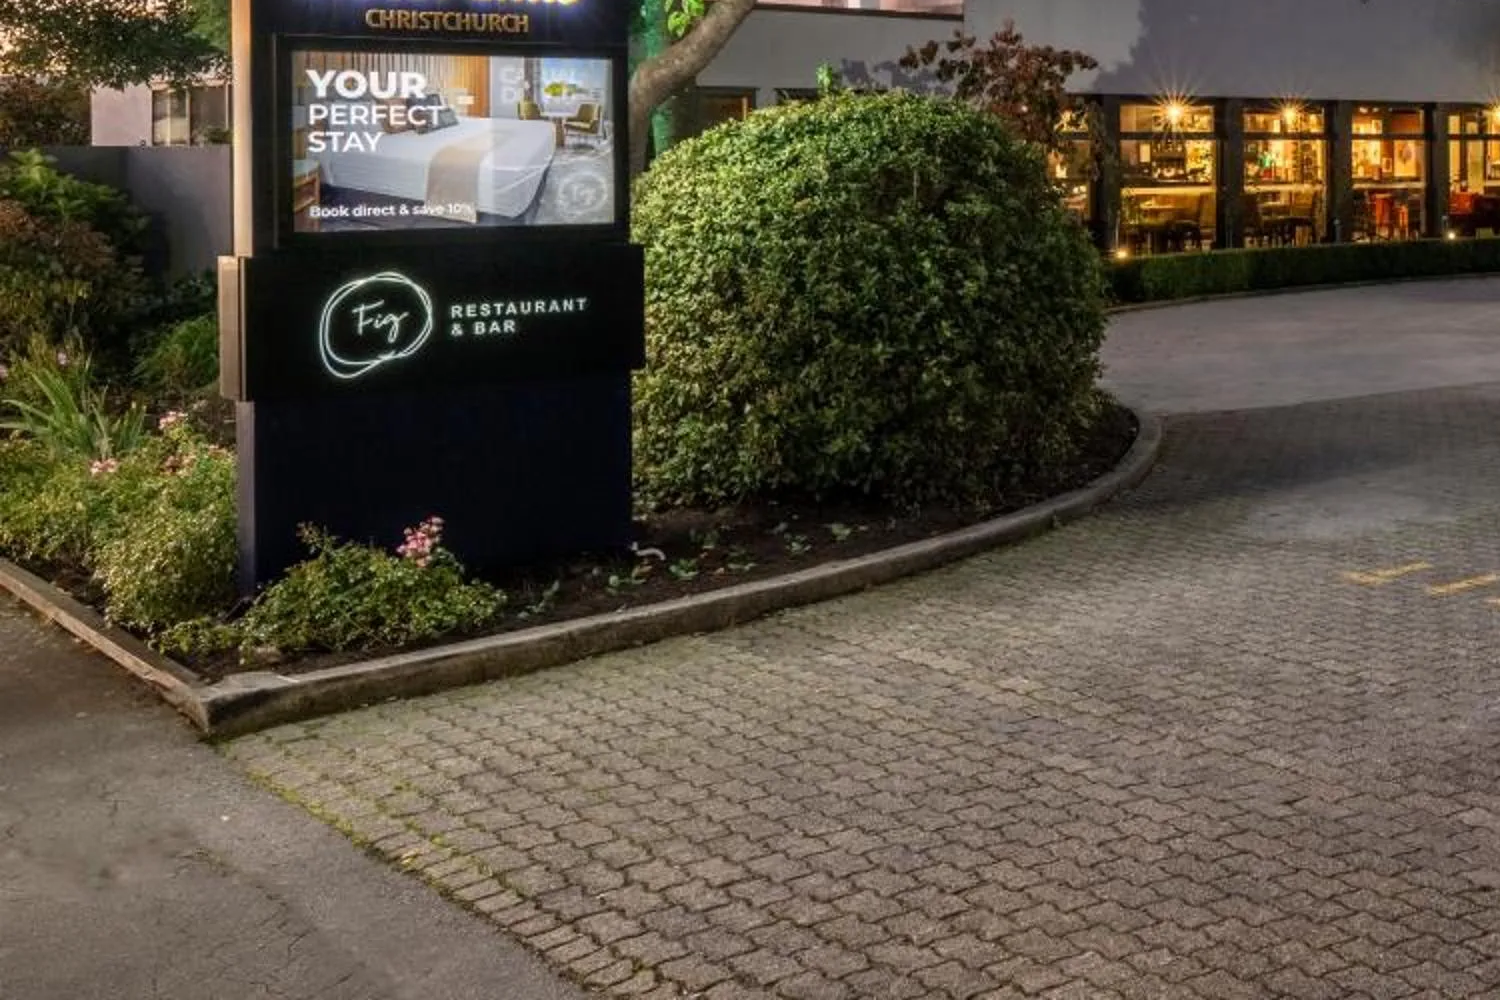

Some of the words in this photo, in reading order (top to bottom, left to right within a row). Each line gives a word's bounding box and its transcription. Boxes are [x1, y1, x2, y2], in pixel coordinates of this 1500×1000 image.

[365, 8, 529, 32] CHRISTCHURCH
[305, 69, 427, 99] YOUR
[308, 104, 443, 126] PERFECT
[307, 130, 383, 153] STAY
[309, 205, 349, 218] Book
[352, 203, 396, 217] direct
[399, 204, 410, 216] &
[412, 204, 445, 216] save
[450, 297, 588, 319] RESTAURANT
[352, 299, 410, 343] Fig
[450, 323, 463, 337] &
[474, 319, 516, 336] BAR
